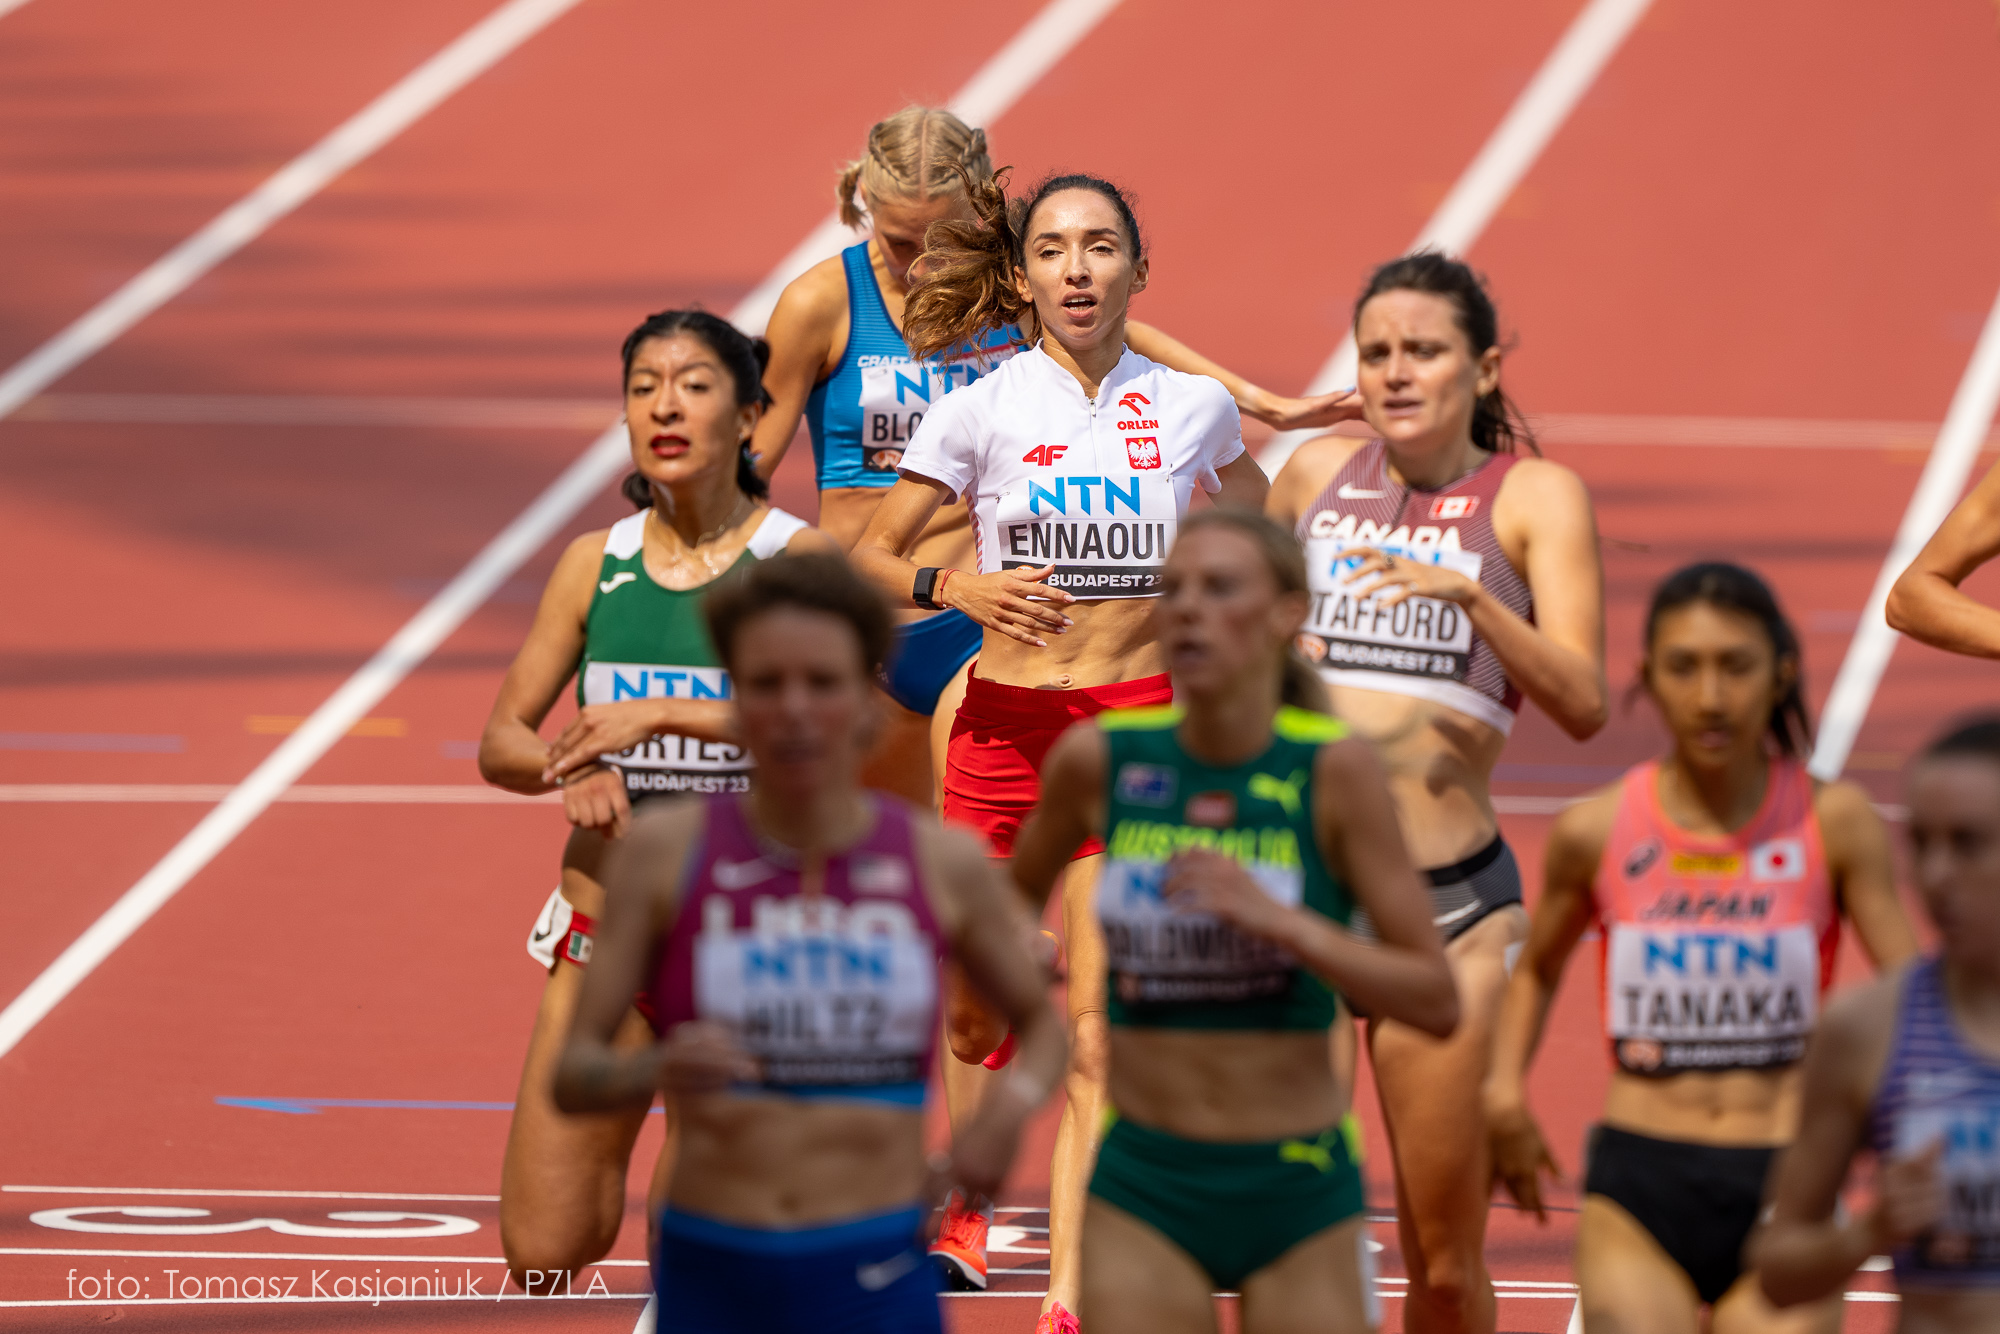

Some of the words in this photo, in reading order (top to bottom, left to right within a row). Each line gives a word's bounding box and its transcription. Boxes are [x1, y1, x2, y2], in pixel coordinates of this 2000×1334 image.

[1117, 420, 1159, 430] ORLEN
[1023, 444, 1069, 466] 4F
[1029, 476, 1140, 516] NTN
[1008, 523, 1166, 560] ENNAOUI
[1047, 574, 1142, 587] BUDAPEST
[1329, 641, 1430, 672] BUDAPEST
[613, 670, 731, 701] NTN
[626, 773, 727, 793] BUDAPEST
[729, 776, 750, 793] 23
[1644, 934, 1780, 976] NTN
[1622, 985, 1805, 1029] TANAKA
